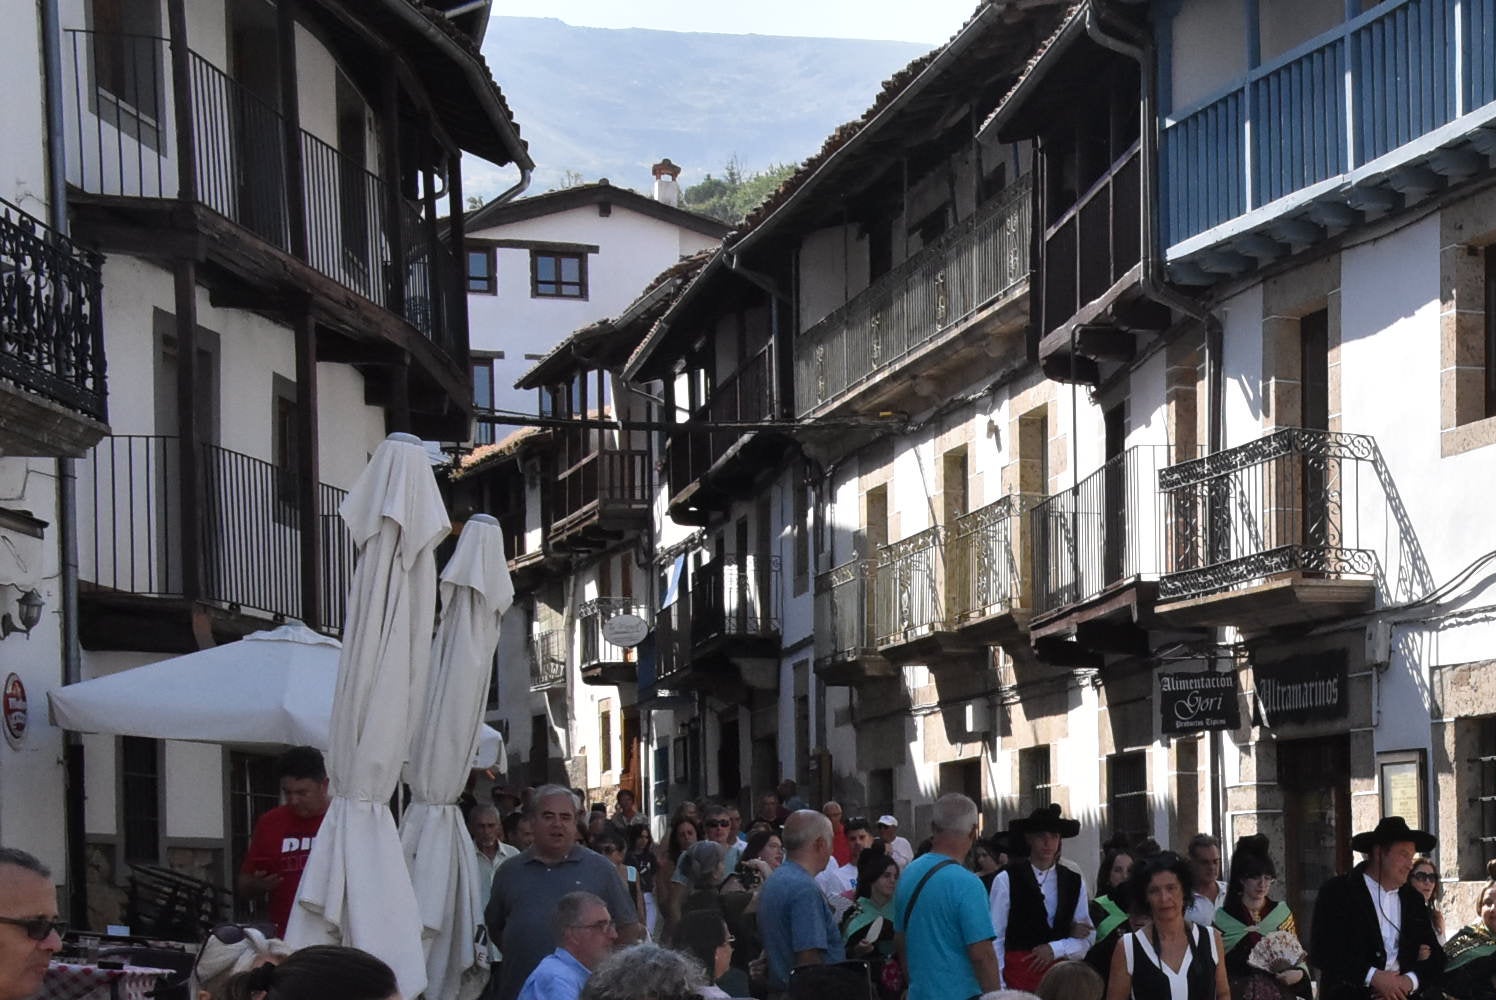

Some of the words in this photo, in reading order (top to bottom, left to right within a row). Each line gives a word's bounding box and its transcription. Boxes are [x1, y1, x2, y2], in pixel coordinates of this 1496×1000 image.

[1161, 672, 1234, 692] Alimentación
[1259, 672, 1339, 713] Ultramarinos
[1174, 690, 1224, 720] Gori
